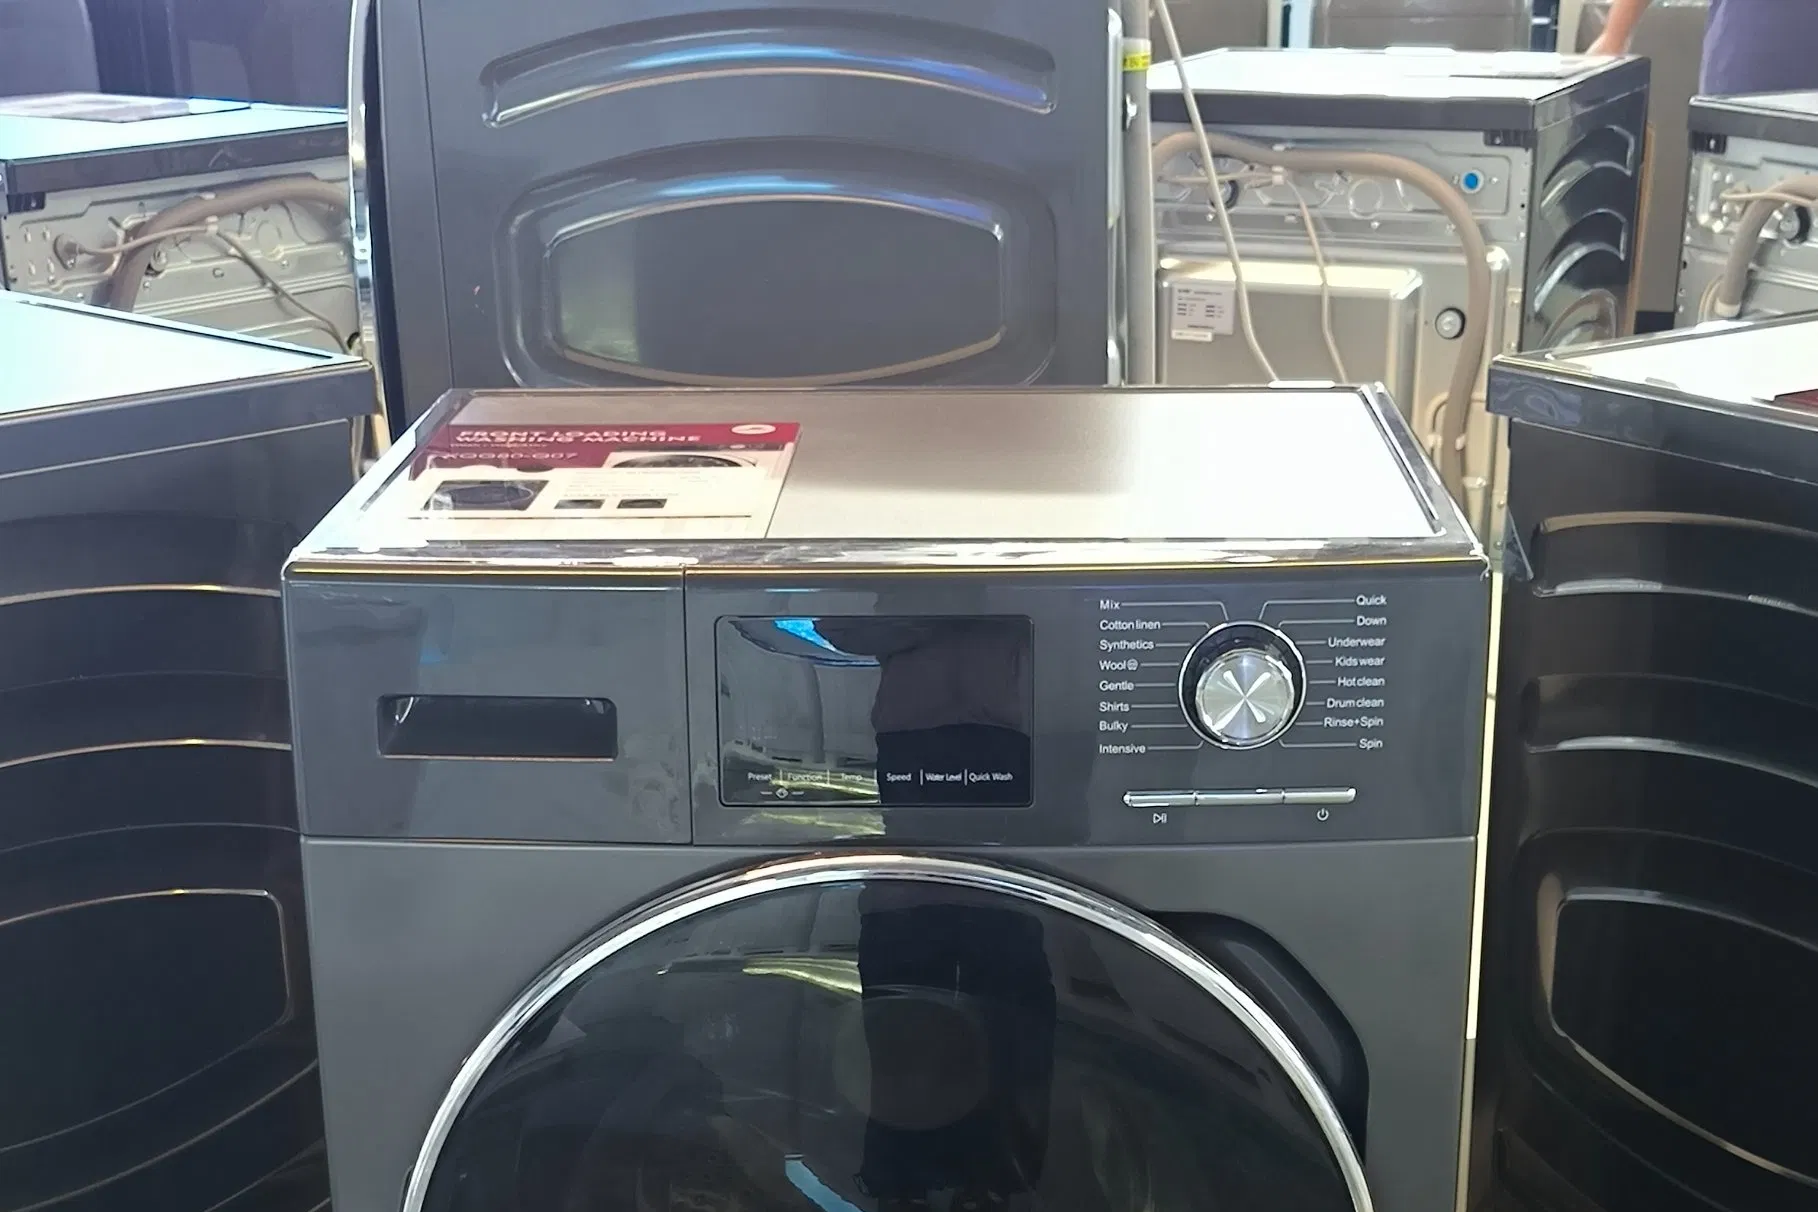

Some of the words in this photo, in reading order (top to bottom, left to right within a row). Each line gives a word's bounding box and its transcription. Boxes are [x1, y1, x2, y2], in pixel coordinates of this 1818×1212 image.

[1099, 599, 1120, 610] Mix
[1356, 595, 1387, 606] Quick
[1099, 619, 1135, 631] Cotton
[1135, 619, 1161, 630] linen
[1356, 615, 1387, 626] Down
[1099, 639, 1154, 653] Synthetics
[1328, 636, 1386, 648] Underwear
[1099, 660, 1126, 671] Wool
[1099, 680, 1135, 691] Gentle
[1337, 676, 1356, 687] Hot
[1356, 676, 1385, 687] clean
[1099, 701, 1130, 712] Shirts
[1326, 697, 1355, 708] Drum
[1356, 697, 1384, 708] clean
[1099, 720, 1128, 733] Bulky
[1324, 716, 1384, 728] Rinse+Spin
[1099, 743, 1146, 754] Intensive
[1359, 738, 1383, 750] Spin
[747, 772, 772, 782] Preset
[788, 772, 823, 782] Function
[886, 772, 912, 783] Speed
[925, 772, 945, 782] Water
[945, 772, 962, 782] Level
[968, 772, 991, 783] Quick
[992, 772, 1013, 782] Wash
